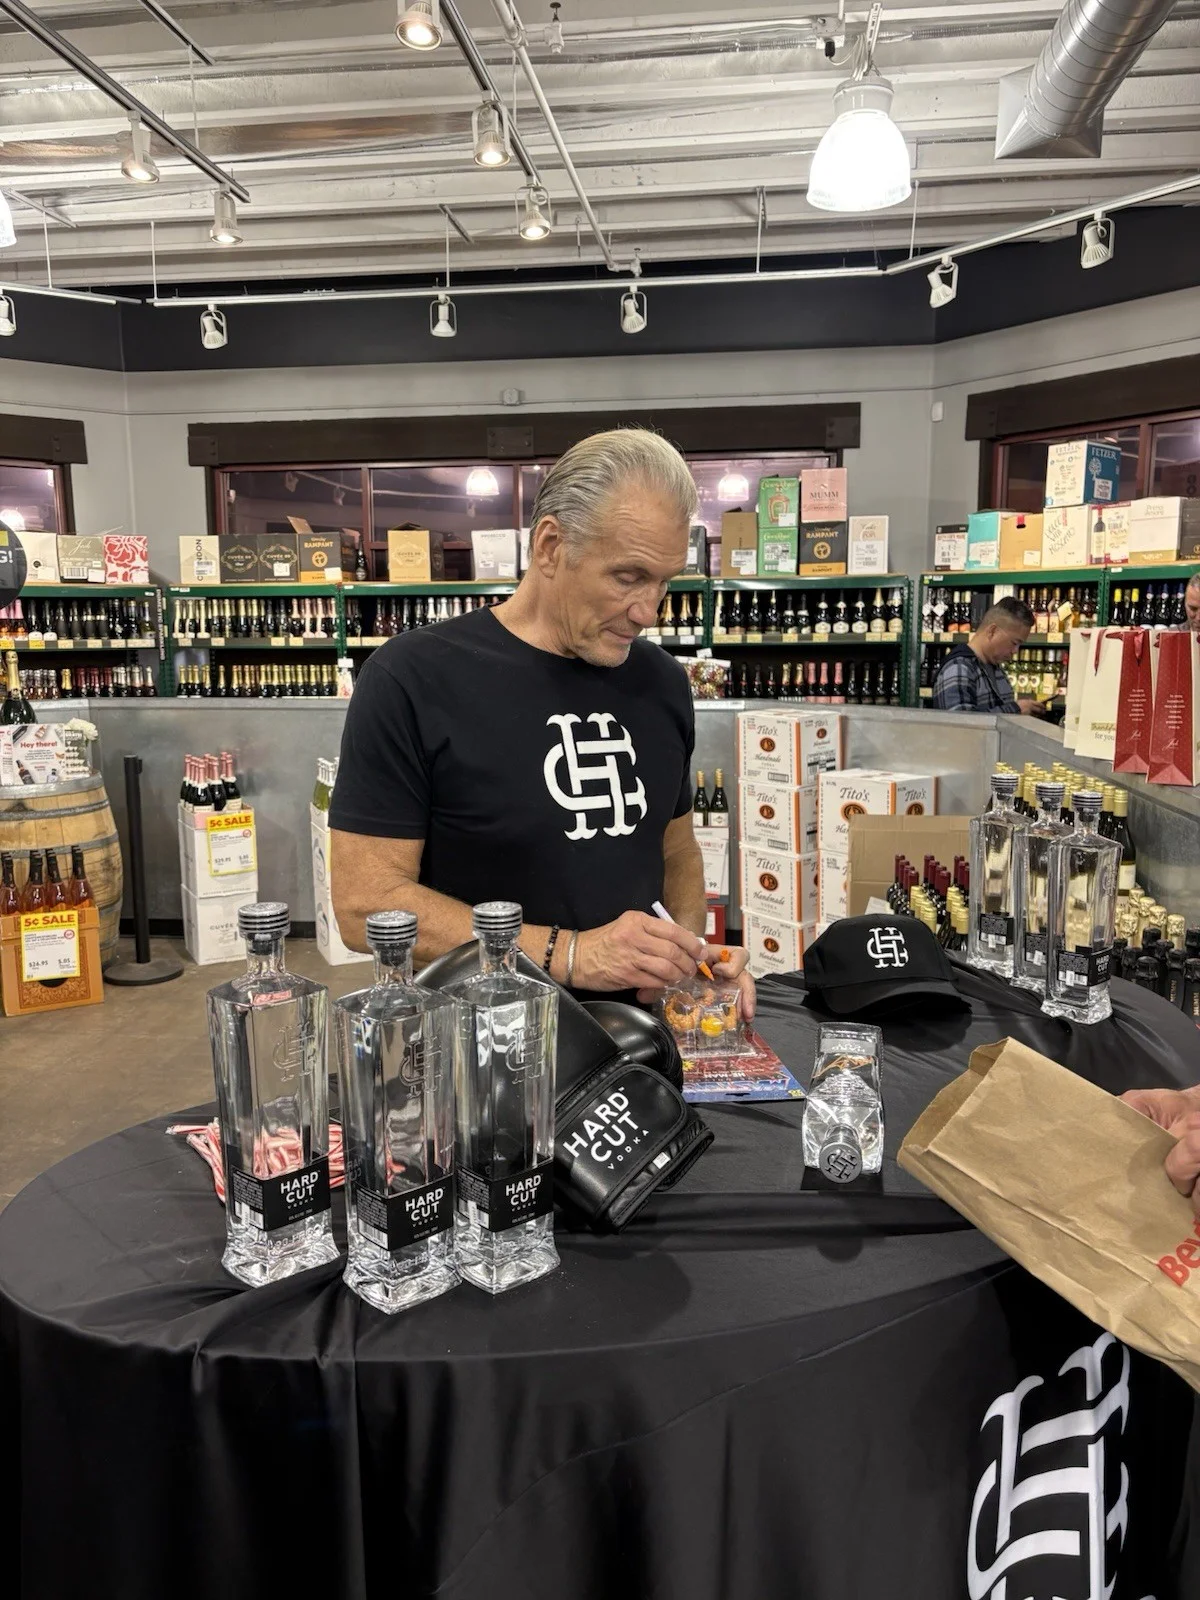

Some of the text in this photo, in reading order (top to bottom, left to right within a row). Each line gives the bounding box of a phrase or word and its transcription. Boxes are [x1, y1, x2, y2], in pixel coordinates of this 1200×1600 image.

[1091, 447, 1117, 460] FETZER
[806, 531, 839, 539] RAMPANT
[757, 725, 778, 736] Tito's
[755, 754, 781, 763] Handmade
[756, 793, 778, 804] Tito's
[840, 786, 870, 802] Tito's
[904, 788, 927, 801] Tito's
[224, 816, 251, 826] SALE
[755, 820, 780, 830] Handmade
[756, 857, 781, 872] Tito's
[753, 891, 785, 905] Handmade
[25, 918, 39, 927] 5¢
[42, 914, 75, 925] SALE
[761, 925, 781, 937] Tito's
[562, 1091, 629, 1158] HARD
[591, 1110, 639, 1162] CUT
[607, 1129, 649, 1170] VODKA
[280, 1171, 319, 1194] HARD
[505, 1174, 541, 1196] HARD
[286, 1184, 315, 1203] CUT
[405, 1188, 444, 1212] HARD
[510, 1187, 537, 1206] CUT
[411, 1201, 440, 1221] CUT
